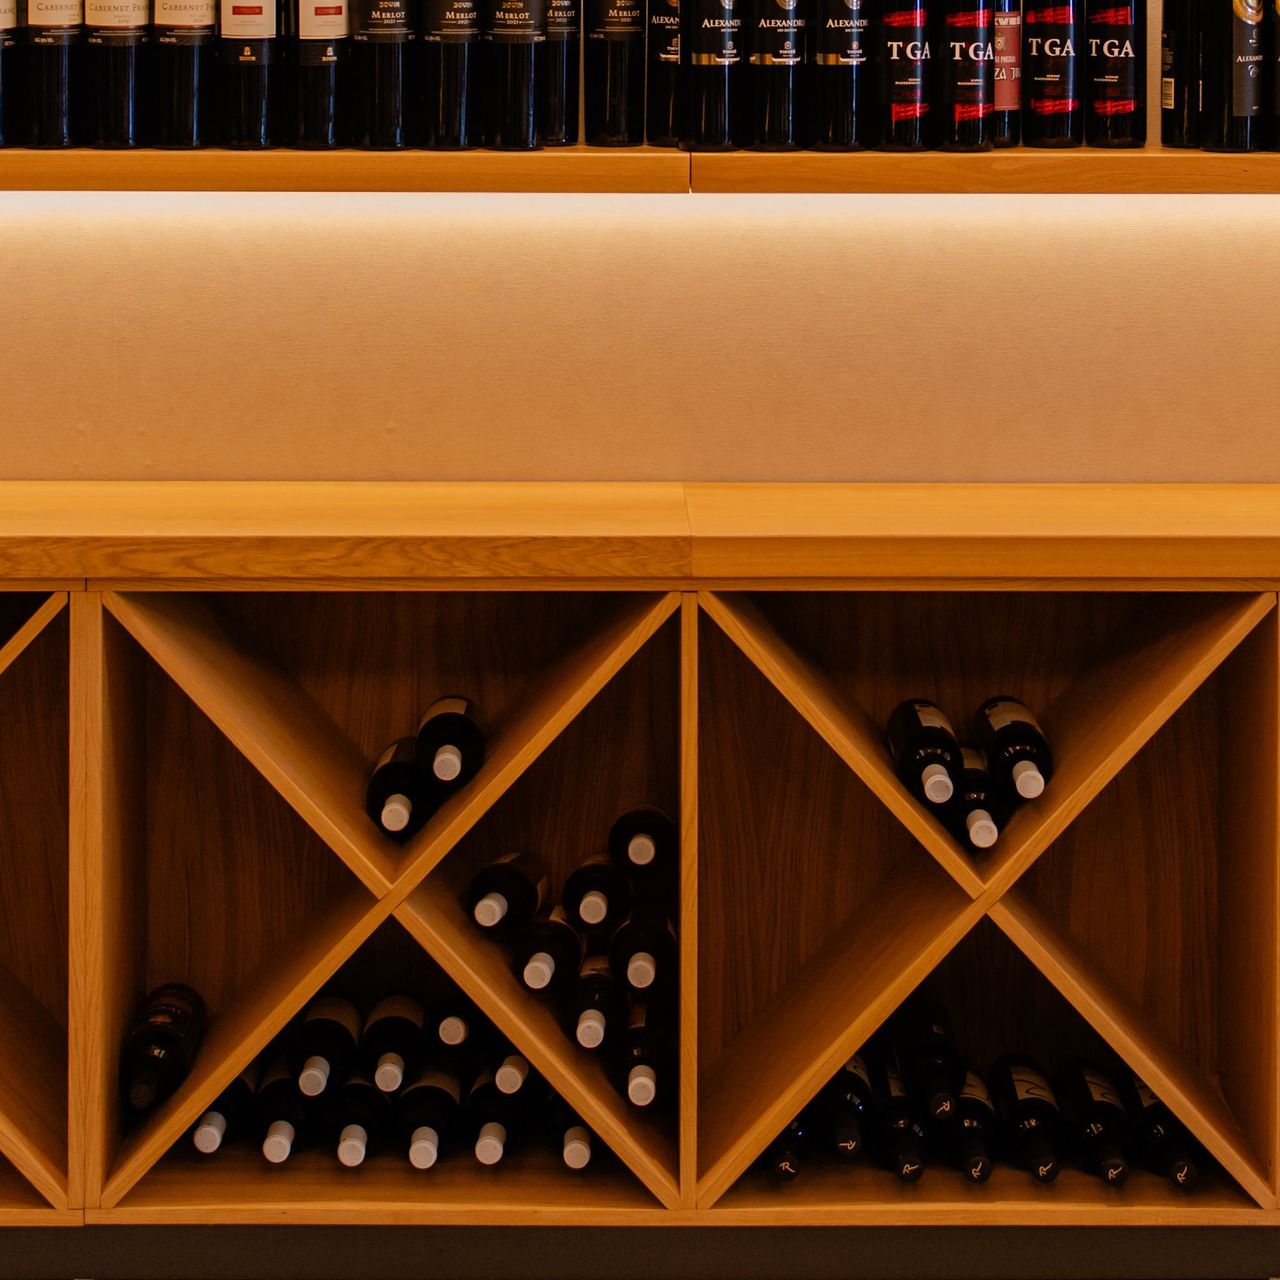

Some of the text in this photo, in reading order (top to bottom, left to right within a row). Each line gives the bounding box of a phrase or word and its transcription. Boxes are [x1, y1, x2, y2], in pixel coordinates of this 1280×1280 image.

[88, 2, 131, 12] CABERNET
[161, 1, 205, 12] CABERNET
[371, 10, 406, 18] MERLOT
[445, 11, 477, 19] MERLOT
[495, 11, 530, 19] MERLOT
[608, 9, 641, 17] MERLOT
[887, 41, 931, 60] TGA
[950, 41, 993, 60] TGA
[1028, 37, 1075, 57] TGA
[1089, 38, 1135, 58] TGA
